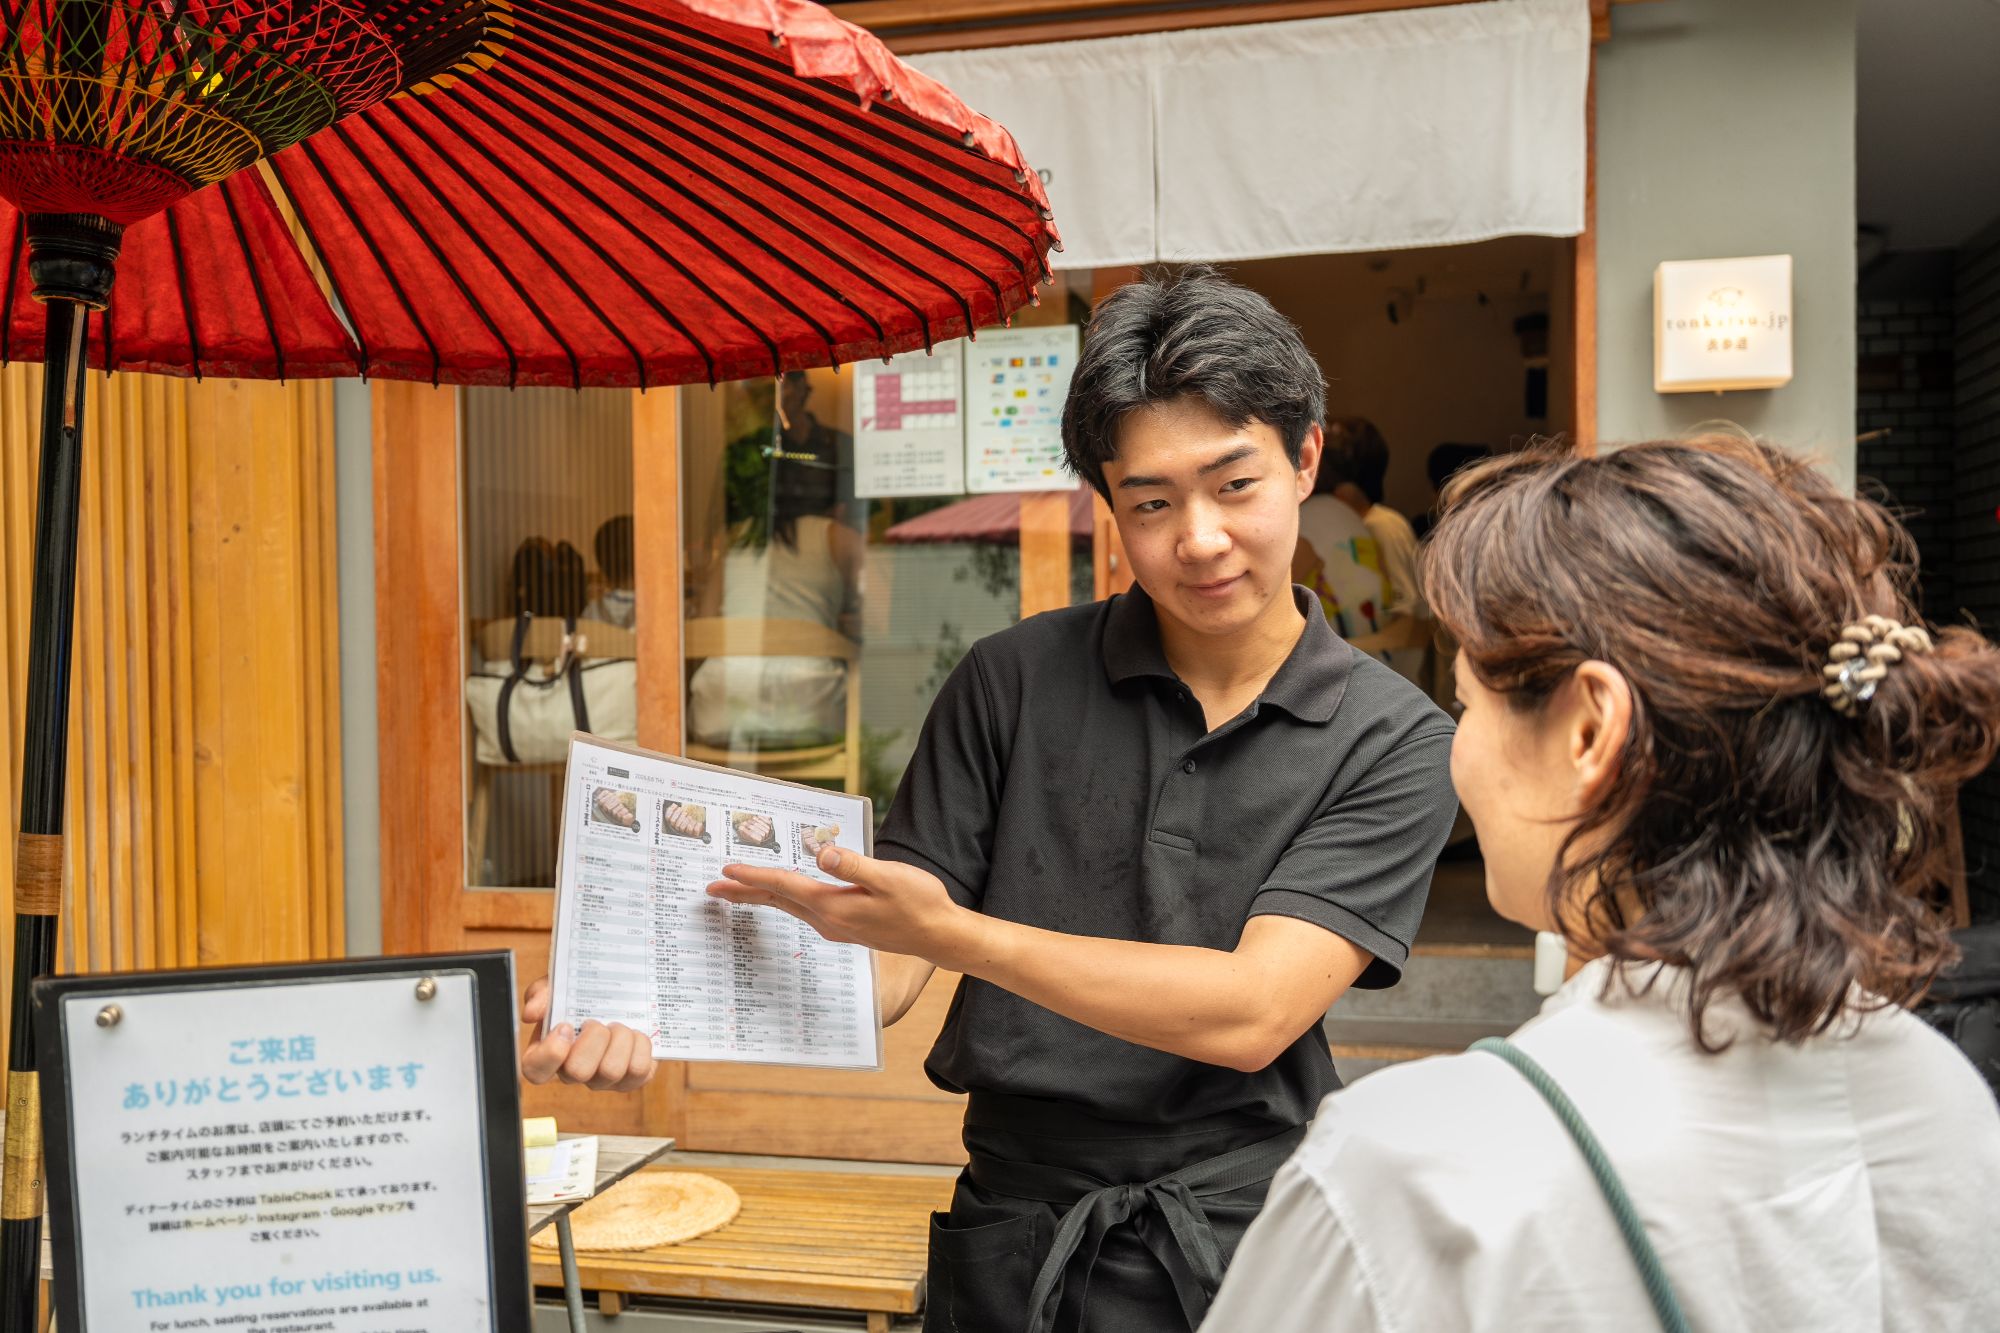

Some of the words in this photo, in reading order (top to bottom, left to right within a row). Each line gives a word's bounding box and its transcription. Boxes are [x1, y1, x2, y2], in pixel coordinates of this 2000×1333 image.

[228, 1036, 316, 1065] ご来店
[123, 1062, 424, 1110] ありがとうございます
[259, 1190, 332, 1204] TableCheck
[131, 1284, 208, 1309] Thank
[215, 1284, 262, 1307] you
[268, 1276, 305, 1296] for
[311, 1269, 401, 1292] visiting
[408, 1268, 442, 1284] us.
[150, 1320, 170, 1332] For
[174, 1317, 210, 1329] lunch,
[214, 1313, 258, 1325] seating
[261, 1305, 336, 1321] reservations
[339, 1305, 359, 1314] are
[361, 1299, 413, 1312] available
[416, 1298, 429, 1308] at
